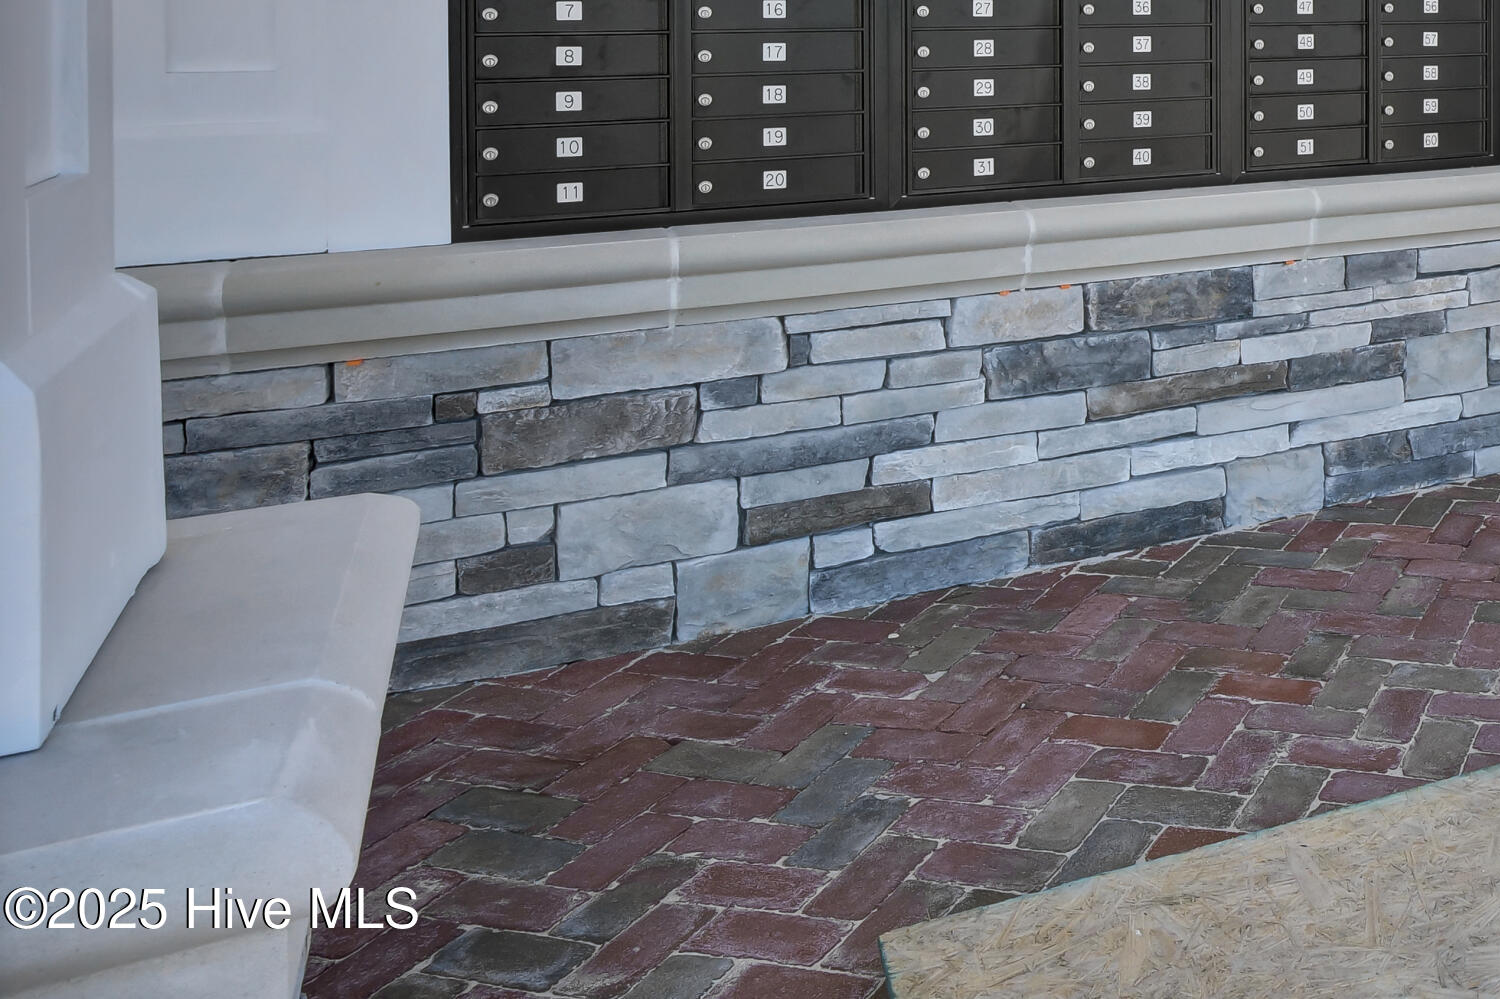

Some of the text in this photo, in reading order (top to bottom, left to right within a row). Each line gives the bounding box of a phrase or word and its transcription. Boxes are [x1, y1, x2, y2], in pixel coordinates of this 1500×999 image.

[565, 4, 574, 18] 7
[767, 2, 783, 16] 16
[975, 1, 991, 15] 27
[1135, 1, 1150, 13] 36
[1298, 1, 1312, 12] 47
[1425, 0, 1437, 12] 56
[1135, 38, 1150, 51] 37
[1299, 36, 1313, 48] 48
[1425, 33, 1437, 45] 57
[767, 45, 783, 59] 17
[976, 41, 992, 55] 28
[564, 49, 574, 64] 8
[1298, 71, 1312, 83] 49
[1424, 67, 1437, 79] 58
[976, 81, 992, 95] 29
[1134, 75, 1150, 88] 38
[767, 87, 783, 102] 18
[564, 94, 574, 109] 9
[1425, 100, 1437, 112] 59
[1299, 106, 1313, 118] 50
[1135, 113, 1150, 126] 39
[975, 120, 992, 134] 30
[767, 130, 784, 144] 19
[1425, 134, 1437, 146] 60
[560, 140, 580, 155] 10
[1300, 141, 1312, 153] 51
[1134, 150, 1150, 163] 40
[977, 160, 991, 174] 31
[765, 172, 785, 187] 20
[563, 185, 578, 200] 11
